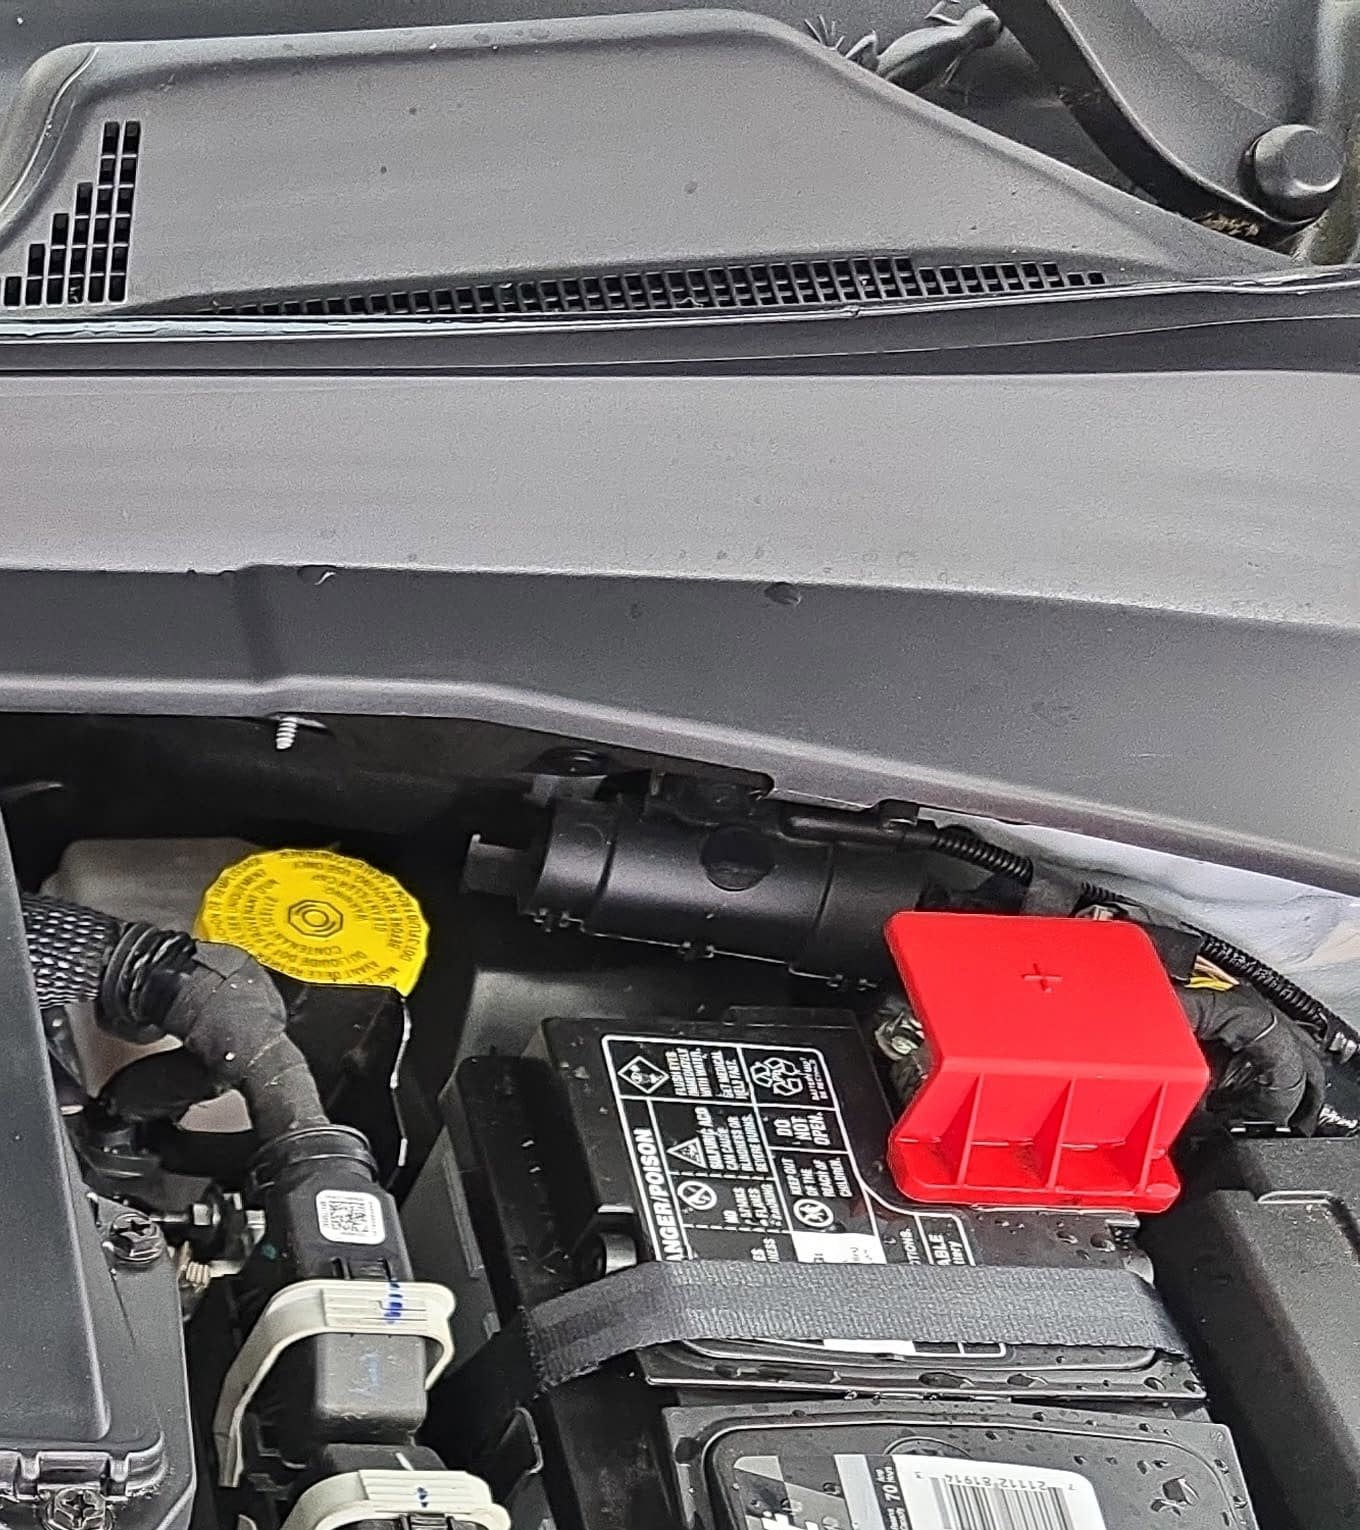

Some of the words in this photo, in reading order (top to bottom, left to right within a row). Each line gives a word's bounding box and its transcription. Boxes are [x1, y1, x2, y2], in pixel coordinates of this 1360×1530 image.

[774, 1119, 792, 1136] DO
[791, 1116, 812, 1140] NOT
[945, 1473, 992, 1487] 81914
[1000, 1477, 1048, 1491] 21112
[883, 1484, 900, 1501] 70
